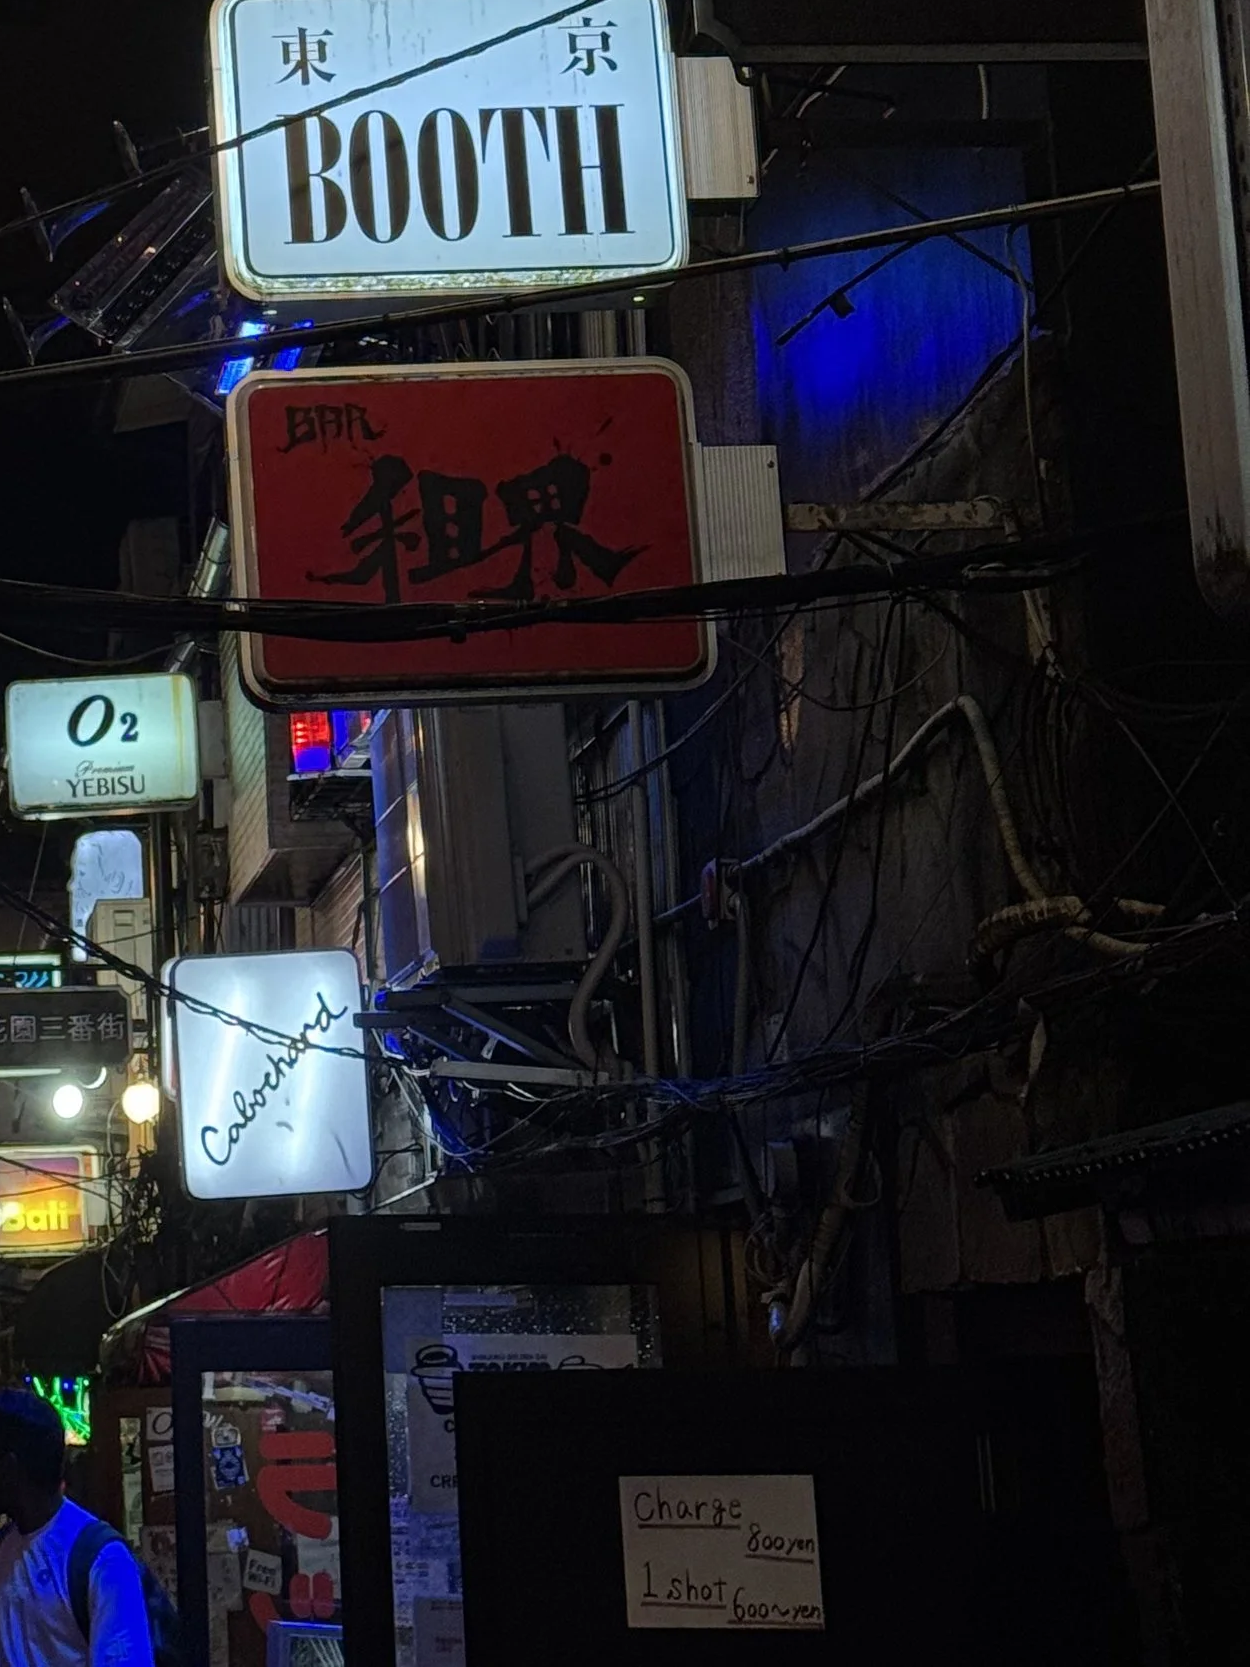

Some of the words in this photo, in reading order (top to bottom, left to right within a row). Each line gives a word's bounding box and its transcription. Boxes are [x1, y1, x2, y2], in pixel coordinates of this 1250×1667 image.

[276, 102, 636, 245] BOOTH
[277, 403, 387, 453] BAR
[67, 694, 139, 747] O2
[66, 774, 145, 798] YEBISU
[634, 1485, 742, 1527] Charge
[643, 1562, 658, 1599] 1
[667, 1568, 727, 1602] shot
